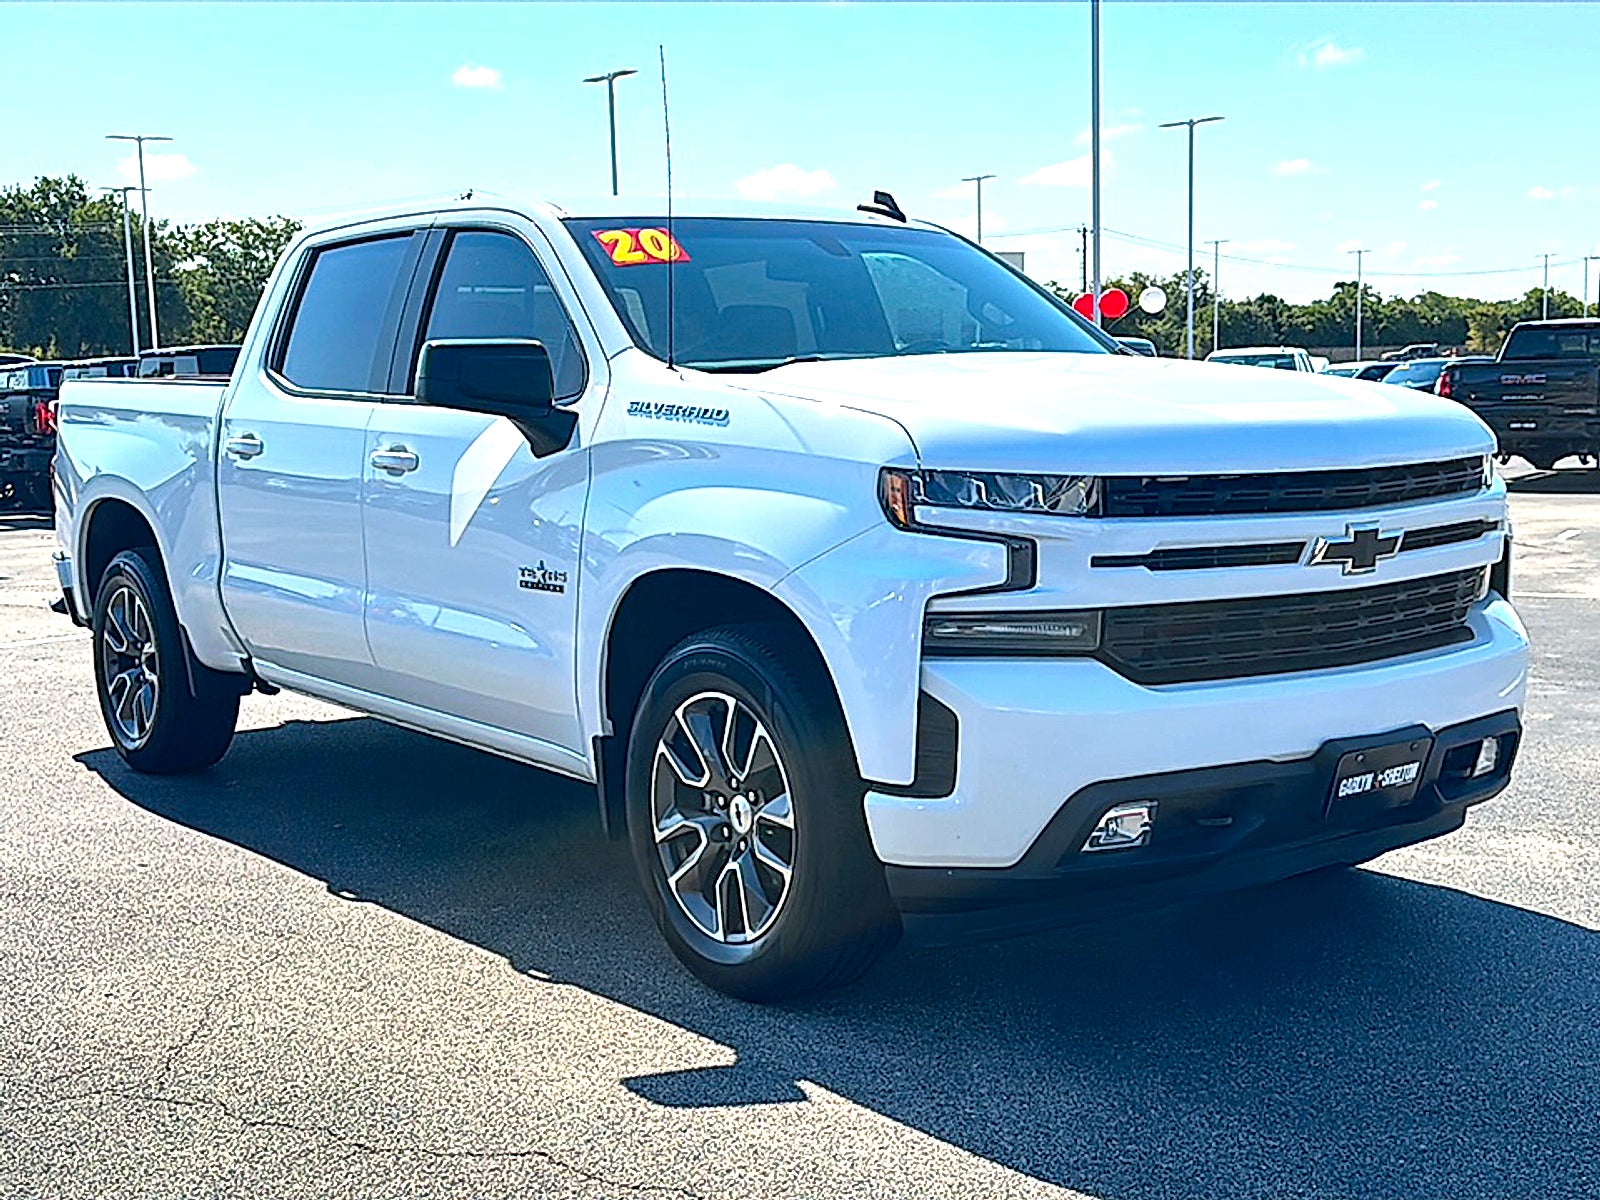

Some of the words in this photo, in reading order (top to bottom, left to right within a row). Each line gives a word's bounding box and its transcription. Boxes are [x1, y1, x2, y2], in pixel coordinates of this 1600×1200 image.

[598, 228, 680, 264] 20
[1500, 373, 1547, 384] GMC
[626, 402, 730, 424] SILVERADO
